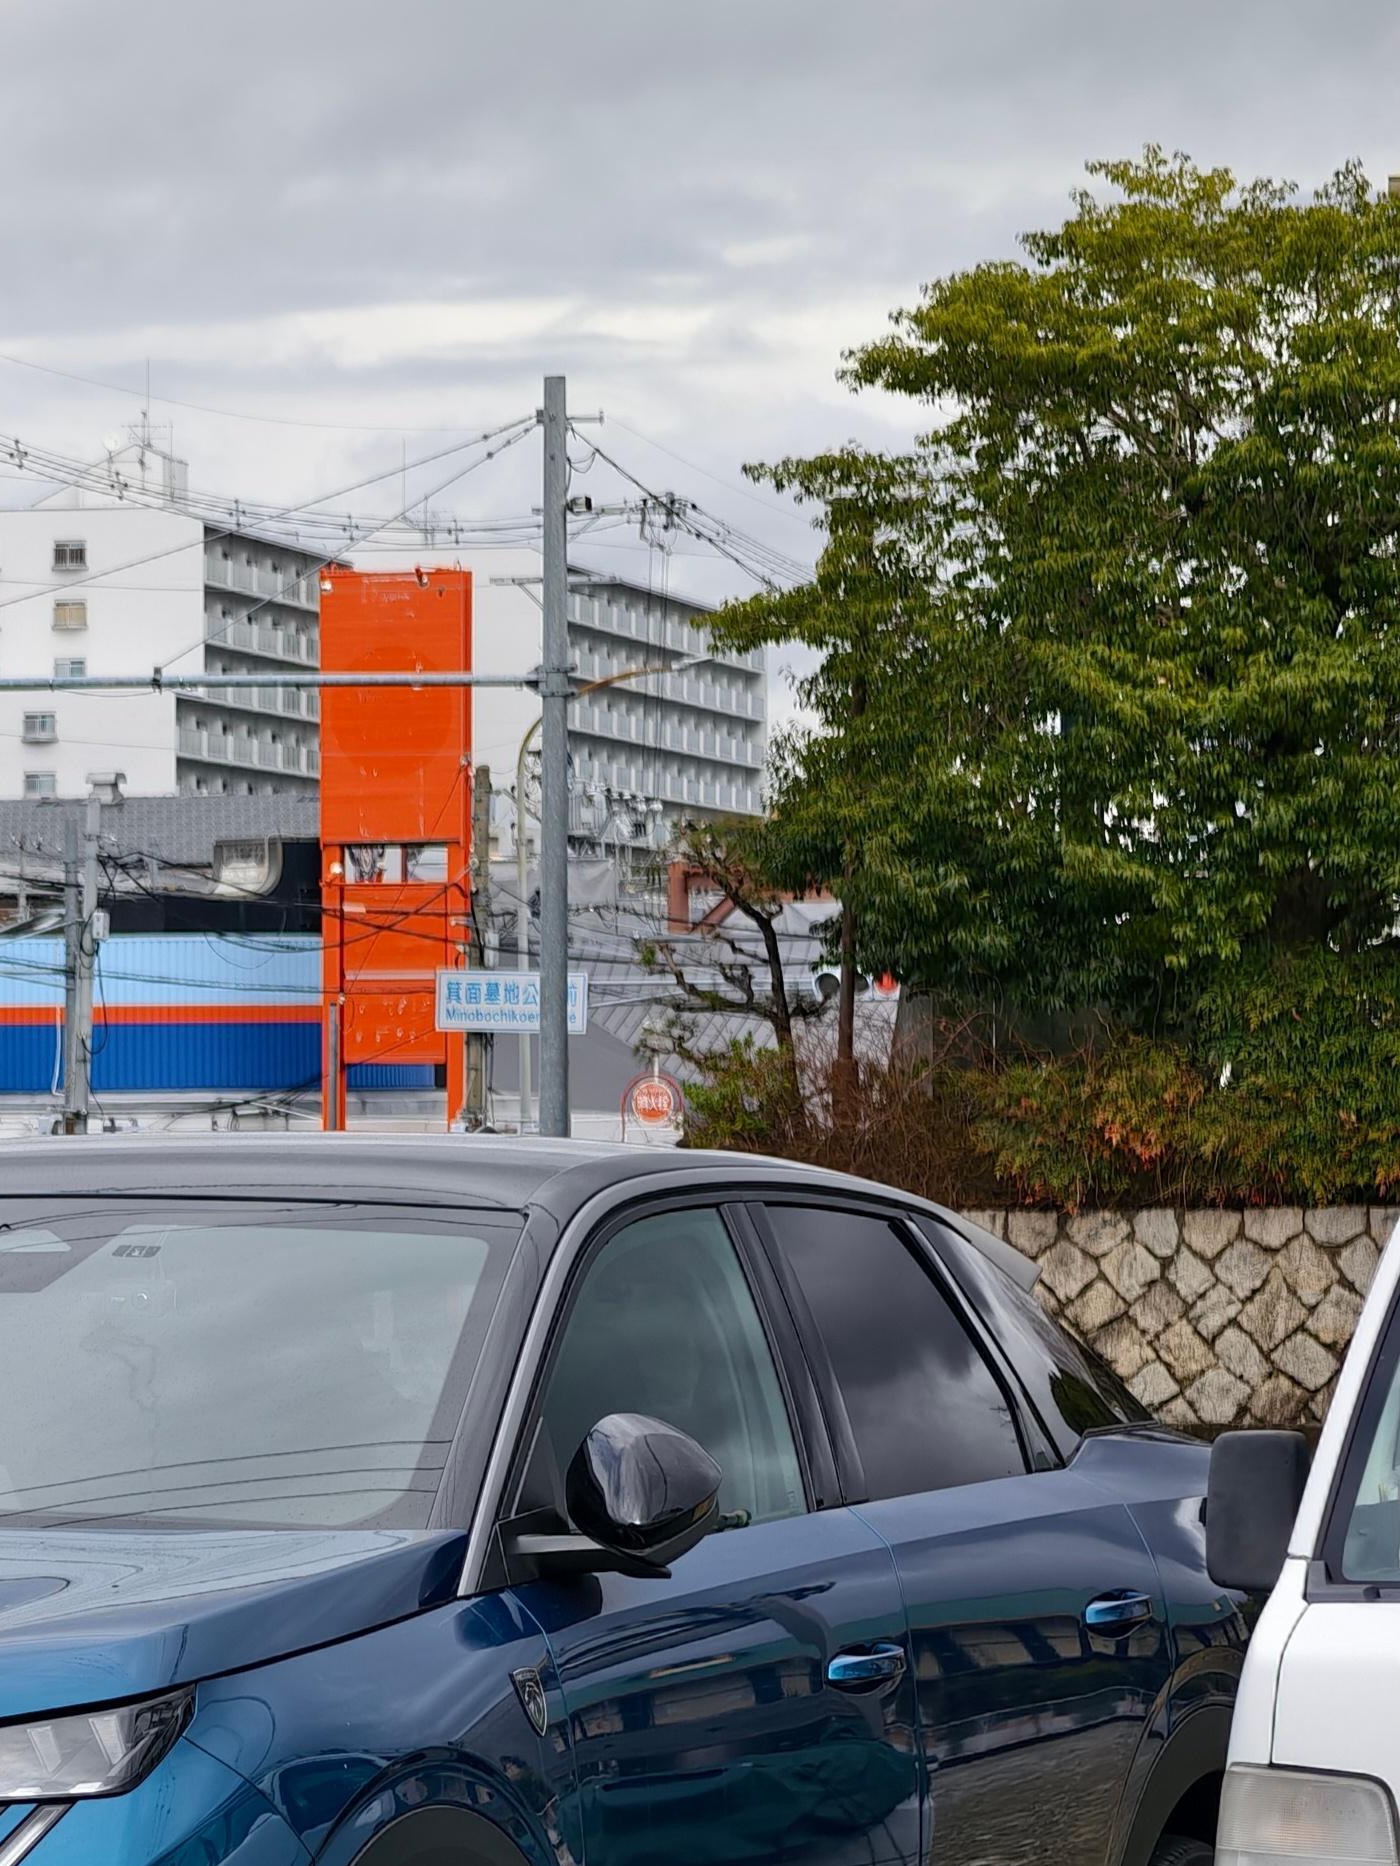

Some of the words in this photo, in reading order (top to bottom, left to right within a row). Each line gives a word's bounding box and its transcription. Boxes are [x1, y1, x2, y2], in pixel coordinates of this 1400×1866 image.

[446, 981, 578, 1008] 箕面墓地公前
[446, 1007, 577, 1024] Minobochikoee
